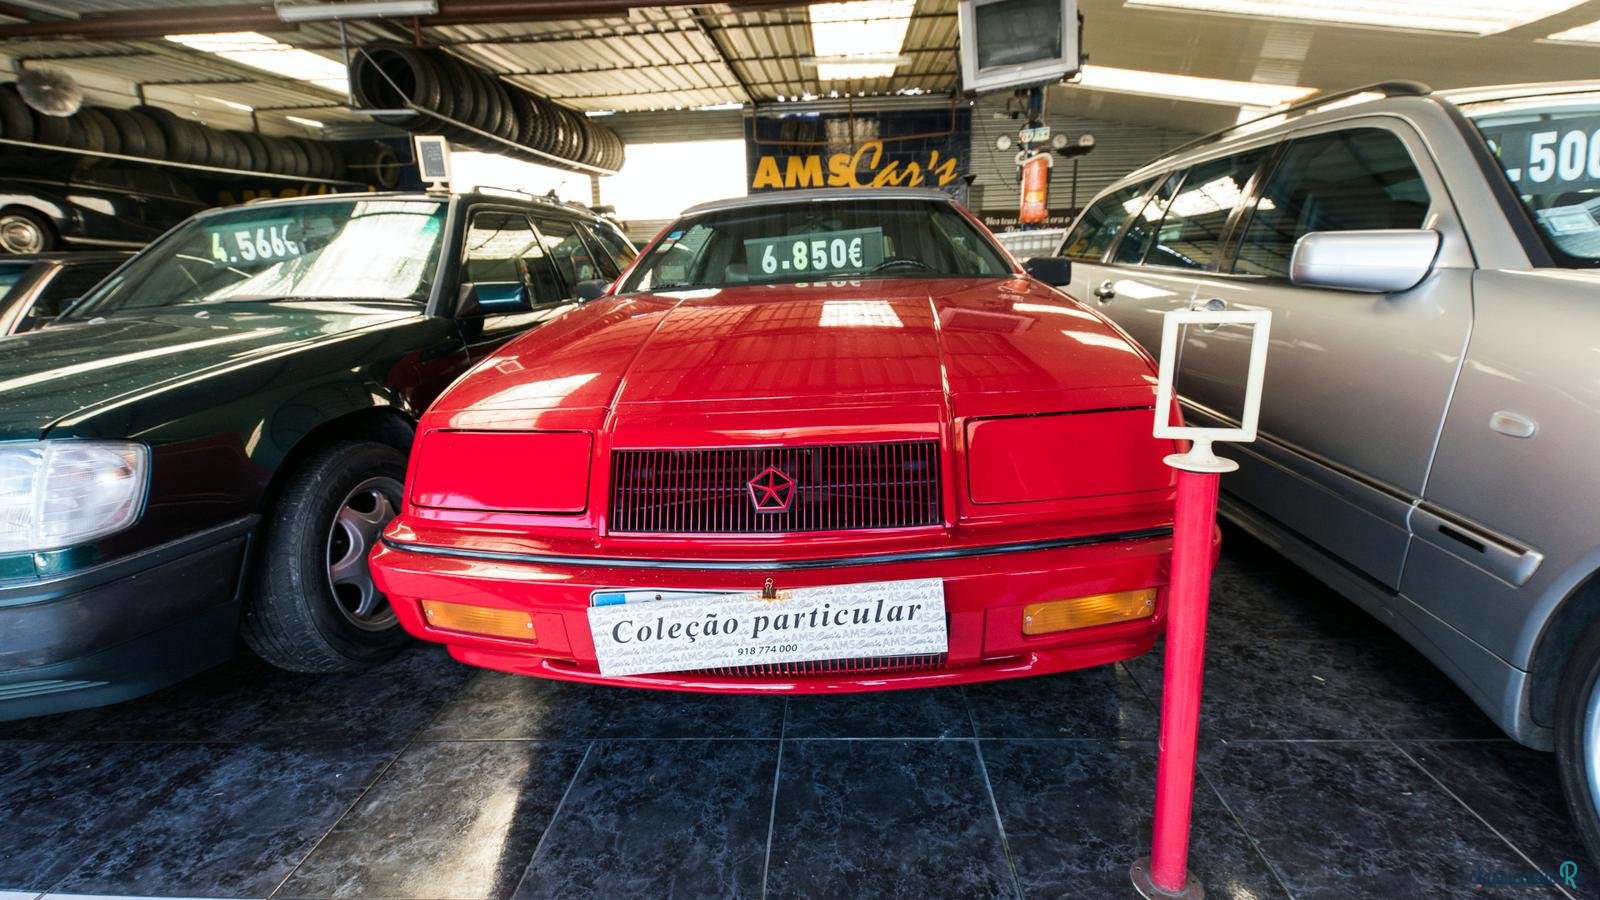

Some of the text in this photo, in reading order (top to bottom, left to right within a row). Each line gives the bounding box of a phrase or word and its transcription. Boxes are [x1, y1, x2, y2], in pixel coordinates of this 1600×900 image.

[761, 237, 863, 274] 6.850€
[612, 613, 739, 644] Coleção
[750, 598, 921, 640] particular
[737, 644, 798, 656] 918 774 000
